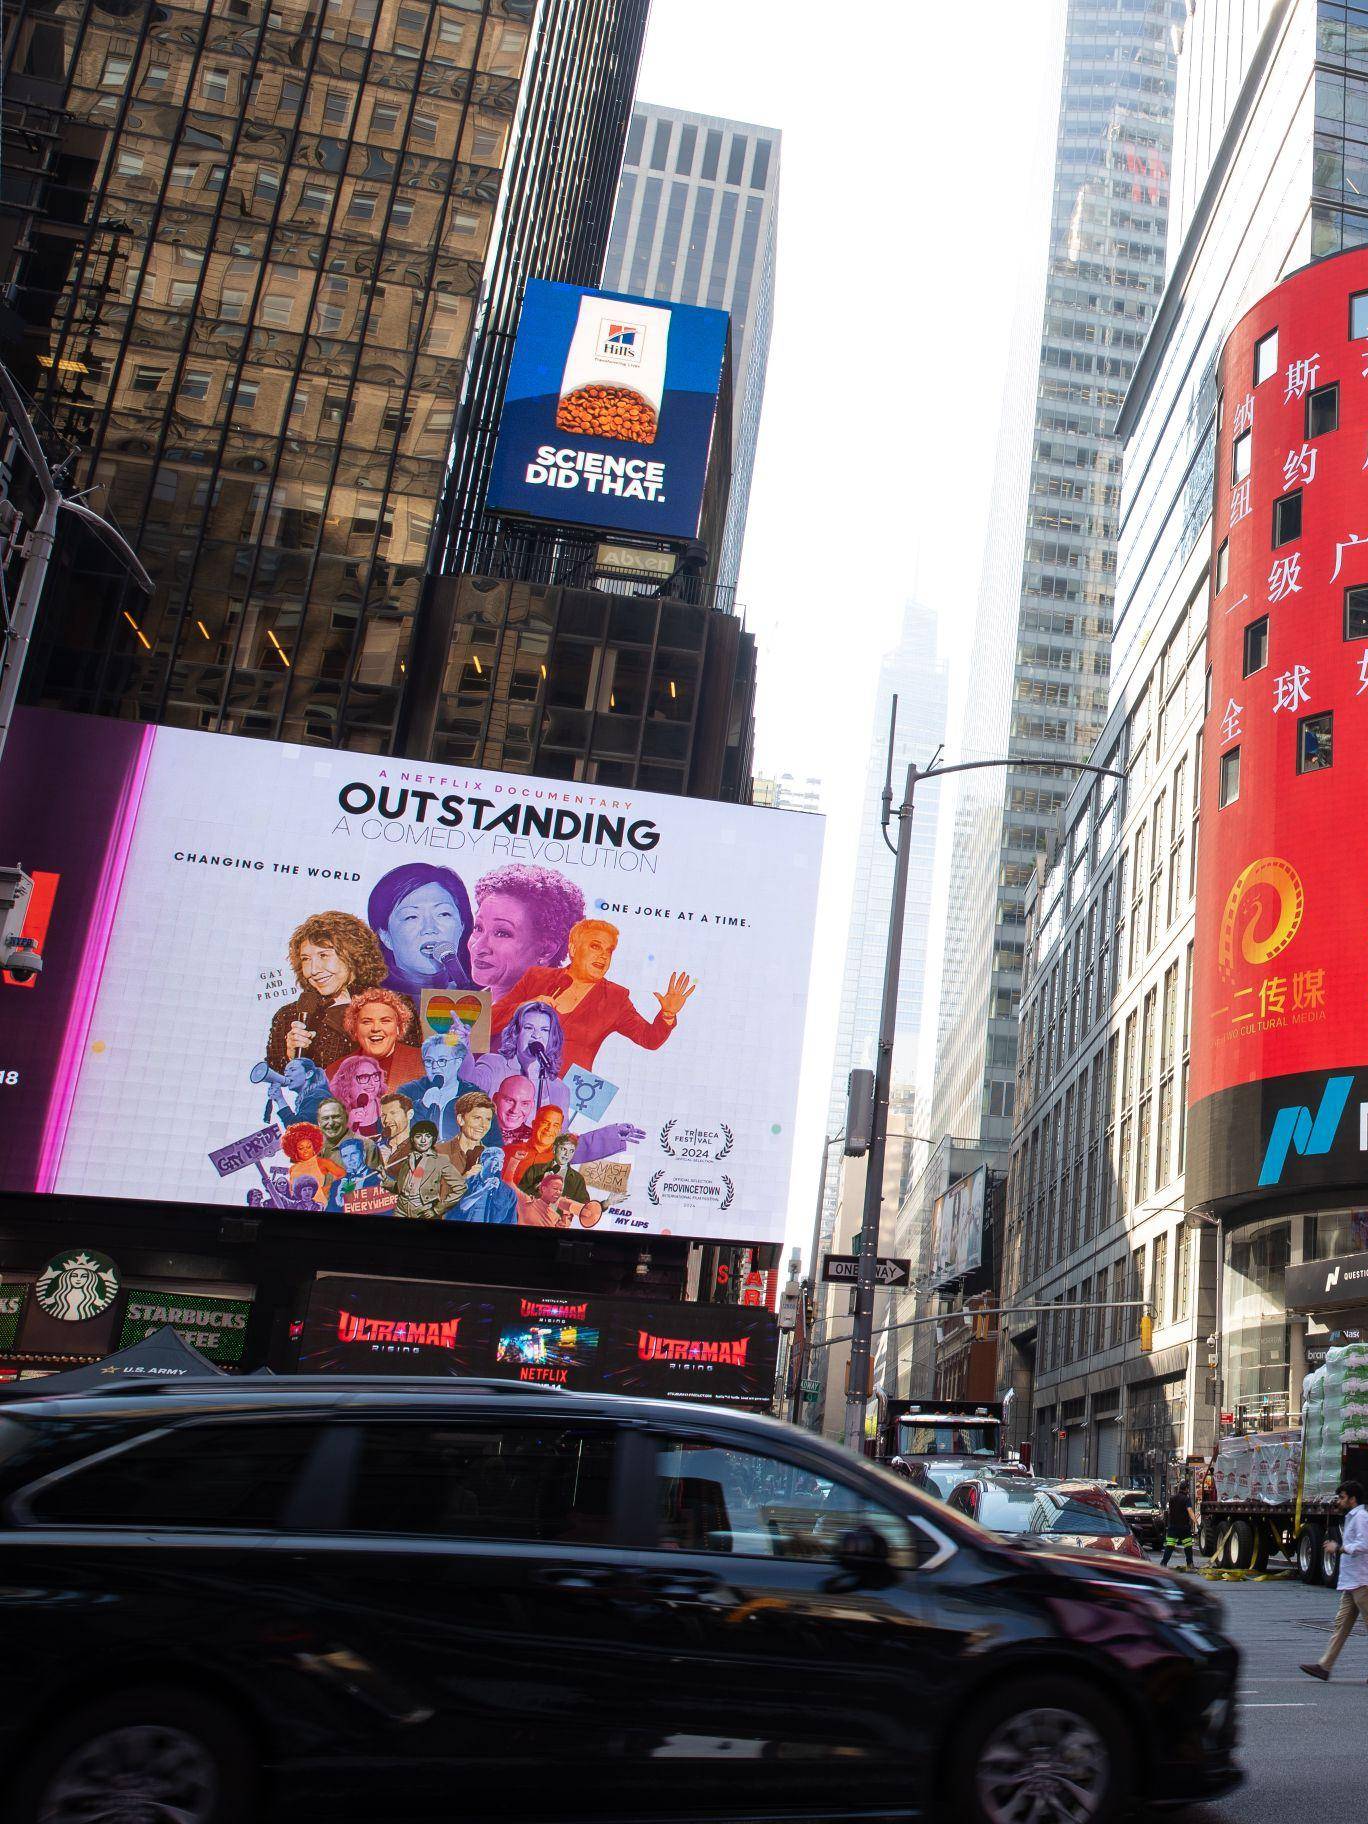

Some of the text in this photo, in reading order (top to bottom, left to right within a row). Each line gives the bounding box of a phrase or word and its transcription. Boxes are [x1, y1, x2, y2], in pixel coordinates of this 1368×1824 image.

[604, 343, 635, 358] Hill's
[536, 446, 666, 483] SCIENCE
[525, 464, 666, 503] DID THAT.
[379, 769, 633, 810] A NETFLIX DOCUMENTARY
[338, 782, 660, 851] OUTSTANDING
[332, 816, 658, 874] A COMEDY REVOLUTION
[174, 852, 361, 882] CHANGING THE WORLD
[600, 902, 751, 928] ONE JOKE AT A TIME.
[259, 968, 284, 980] GAY
[265, 979, 283, 990] AND
[257, 987, 298, 1001] PROUD
[1210, 968, 1326, 1023] 一二传媒
[1240, 1018, 1288, 1036] CULTURAL
[1292, 1010, 1327, 1025] MEDIA
[681, 1148, 709, 1158] 2024
[585, 1168, 623, 1186] SEXISM
[590, 1161, 629, 1176] SMASH
[353, 1188, 367, 1201] WE
[663, 1183, 721, 1196] PROVINCETOWN
[608, 1207, 633, 1217] READ
[615, 1217, 650, 1229] MY LIPS
[835, 1263, 859, 1276] ONE
[129, 1304, 247, 1329] STARBUCKS
[520, 1298, 589, 1320] ULTRAMAN
[337, 1310, 462, 1350] ULTRAMAN
[637, 1329, 751, 1367] ULTRAMAN
[148, 1367, 187, 1376] ARMY
[520, 1367, 569, 1384] NETFLIX
